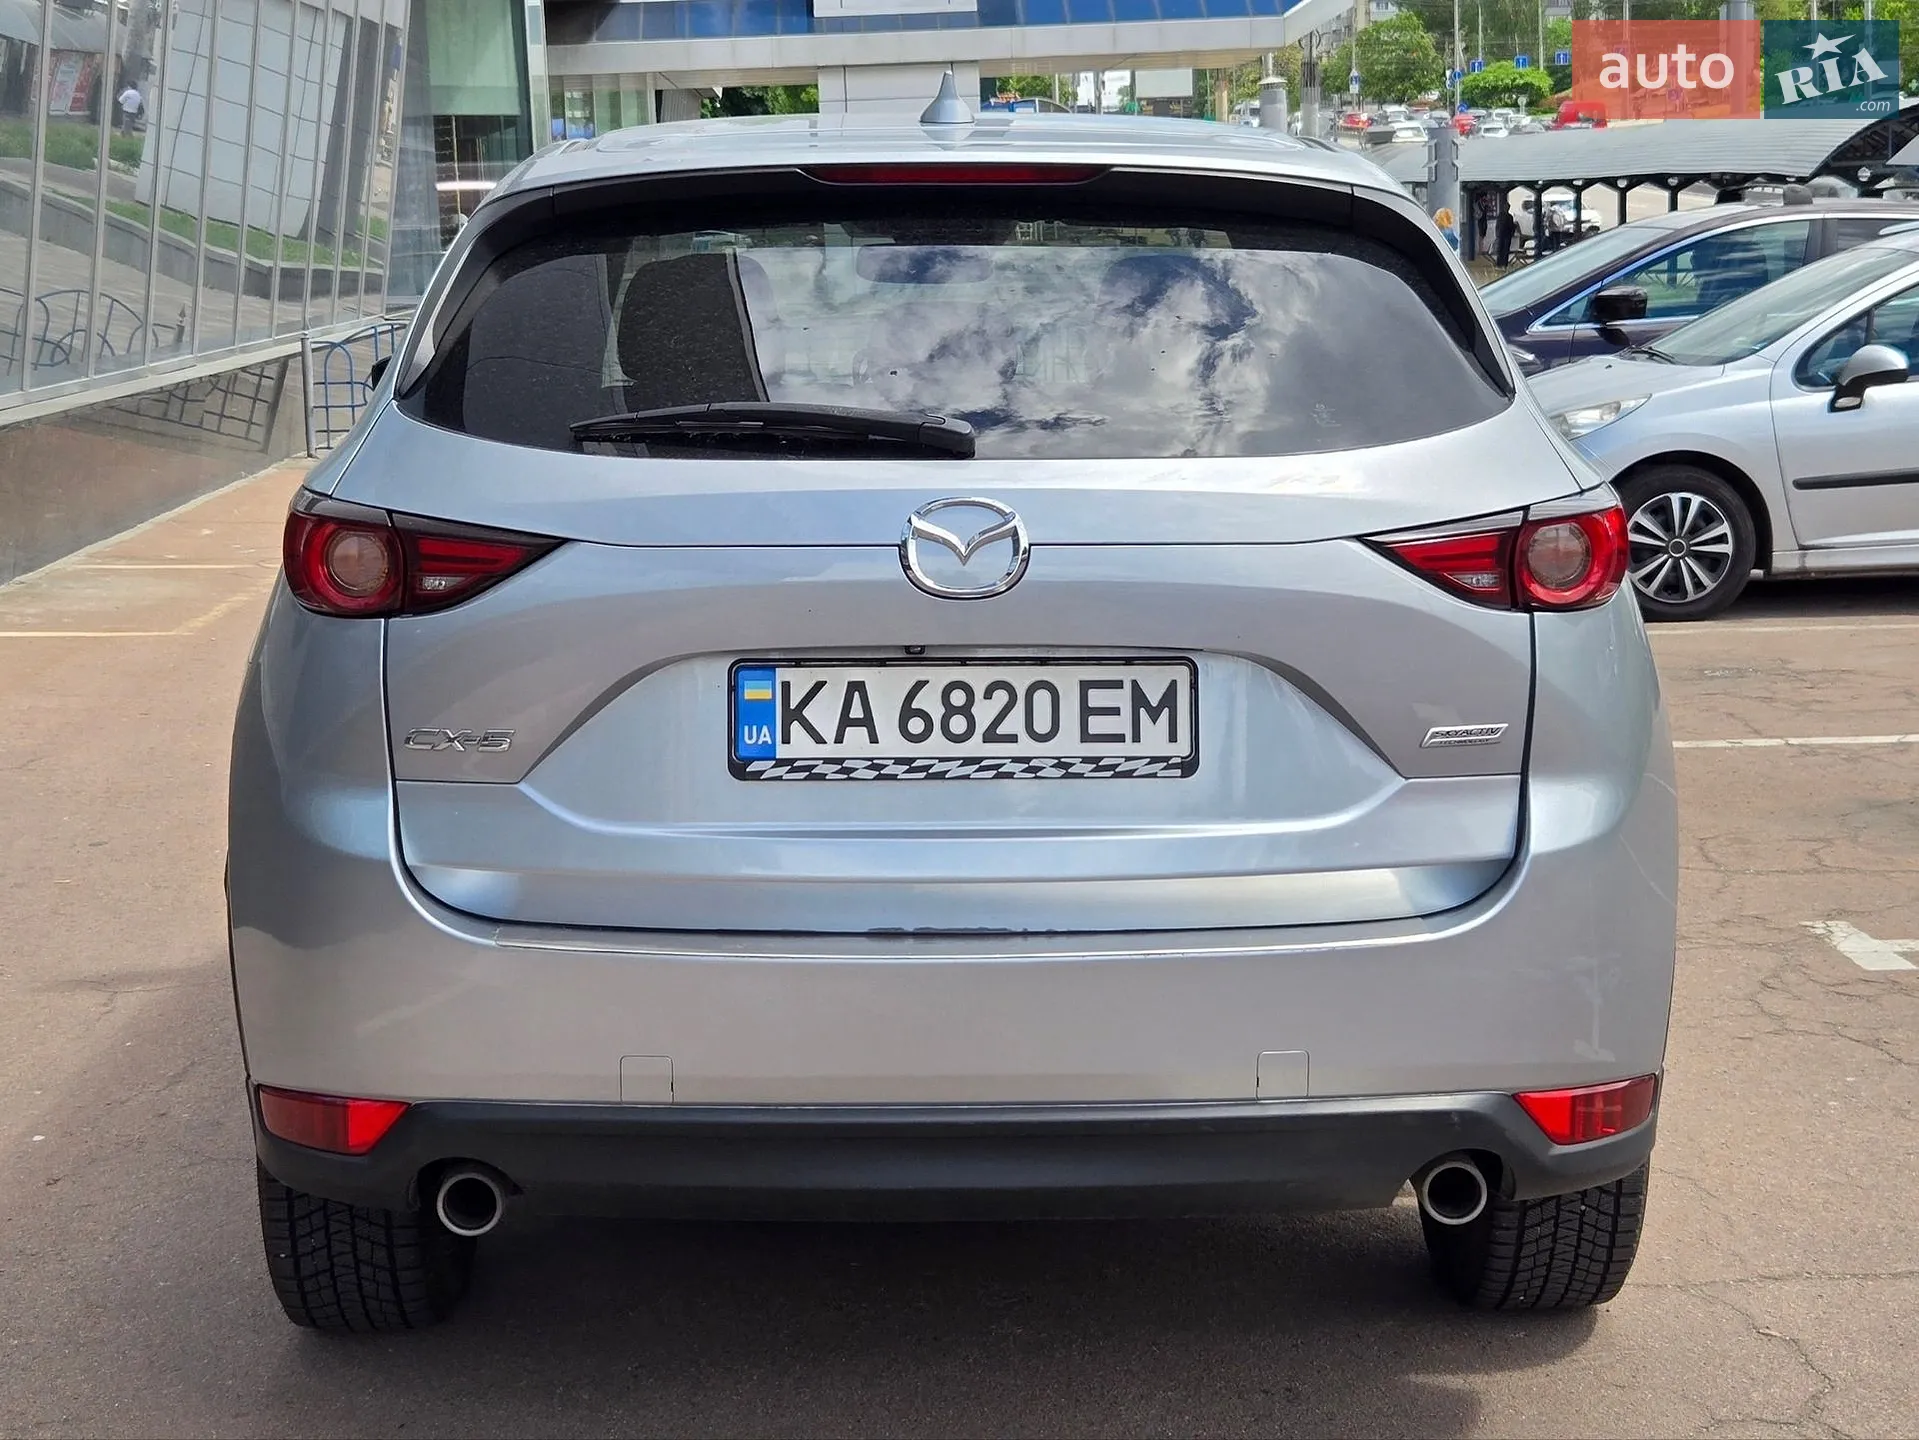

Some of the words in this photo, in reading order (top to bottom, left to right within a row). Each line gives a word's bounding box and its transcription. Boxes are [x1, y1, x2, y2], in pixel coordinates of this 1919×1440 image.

[780, 679, 880, 745] KA
[898, 679, 1061, 745] 6820
[1078, 679, 1179, 745] EM
[404, 727, 516, 752] CX-5
[743, 725, 773, 746] UA
